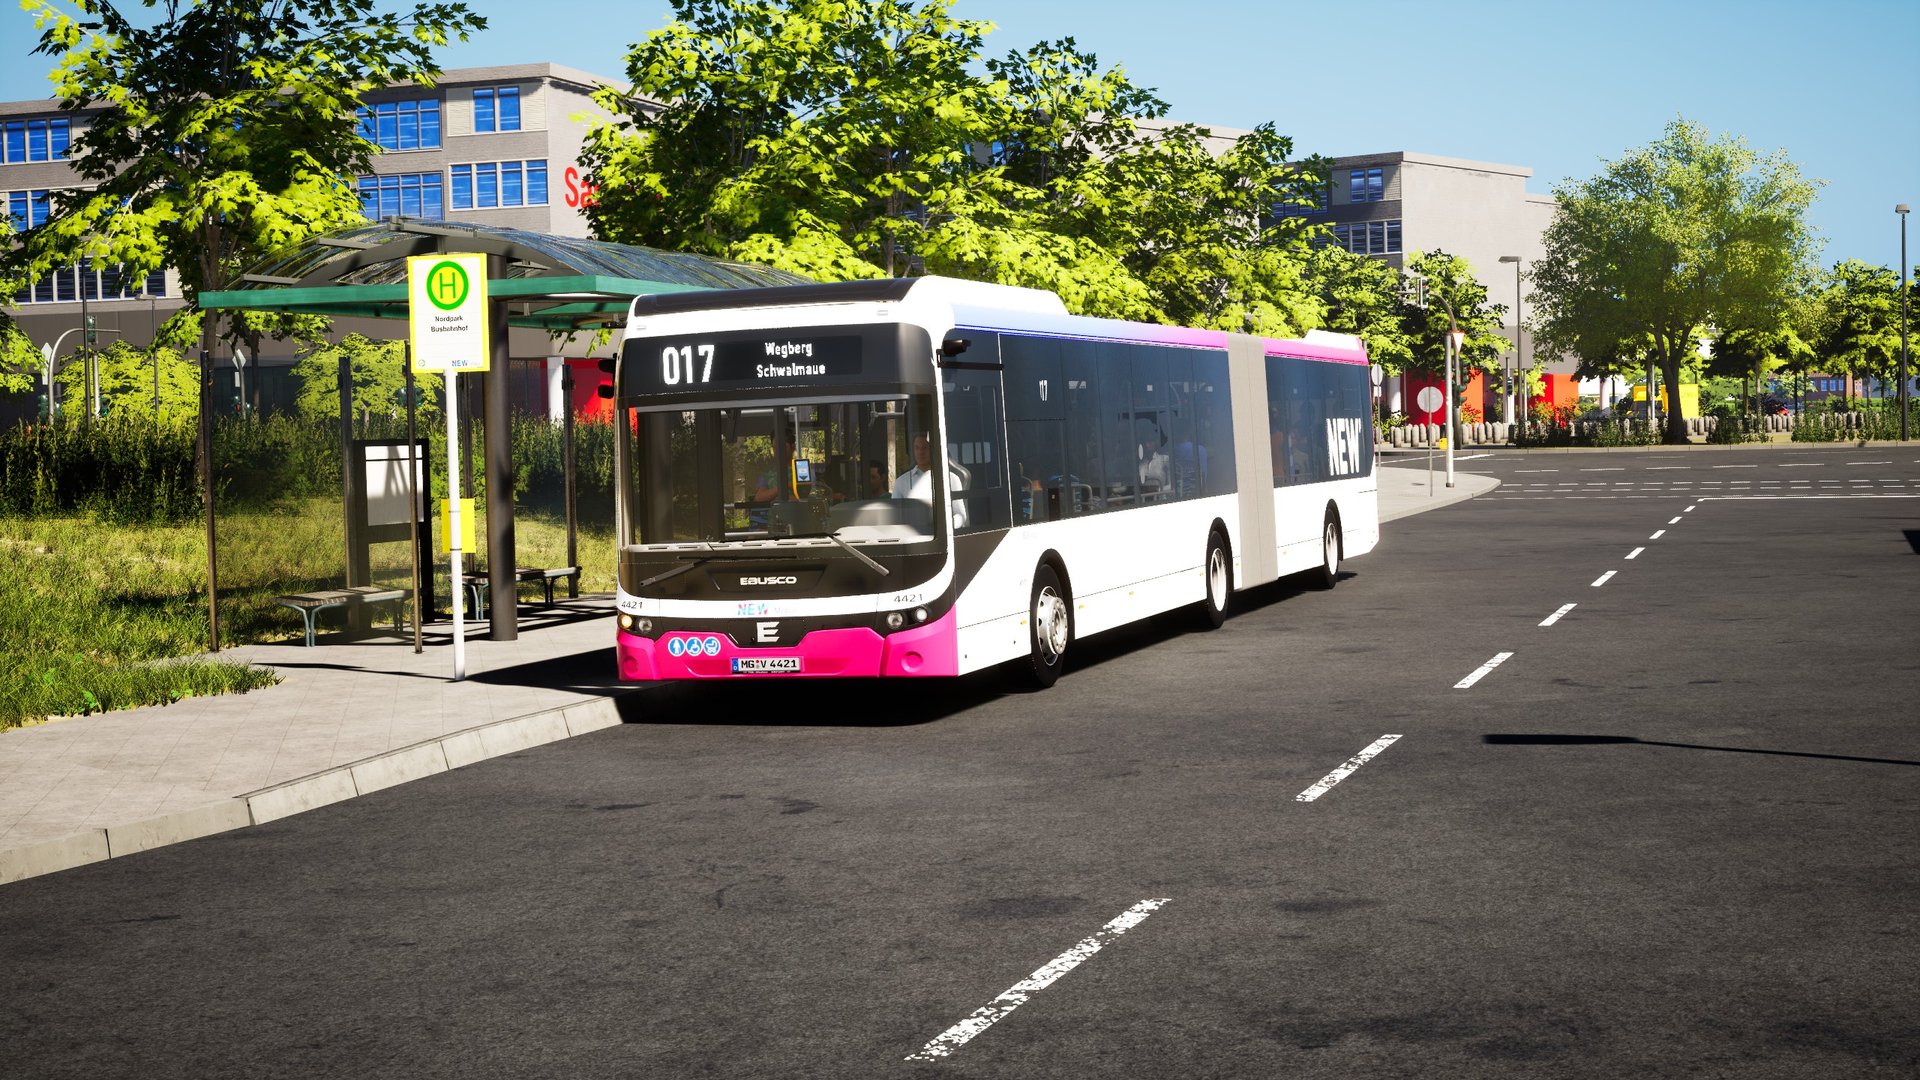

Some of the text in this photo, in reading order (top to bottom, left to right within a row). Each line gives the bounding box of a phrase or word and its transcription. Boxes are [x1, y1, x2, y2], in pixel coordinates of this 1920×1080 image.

[439, 271, 456, 299] H
[434, 315, 464, 323] Nordpark
[430, 325, 469, 333] Busbahnhof
[764, 341, 813, 358] Wegberg
[662, 344, 715, 385] 017
[756, 363, 826, 378] Schwalmaue
[1326, 417, 1362, 476] NEW
[740, 576, 798, 586] EBUSCO
[621, 600, 643, 609] 4421
[893, 593, 923, 603] 4421
[737, 603, 769, 616] NEW
[756, 621, 780, 643] E
[769, 659, 797, 669] 4421
